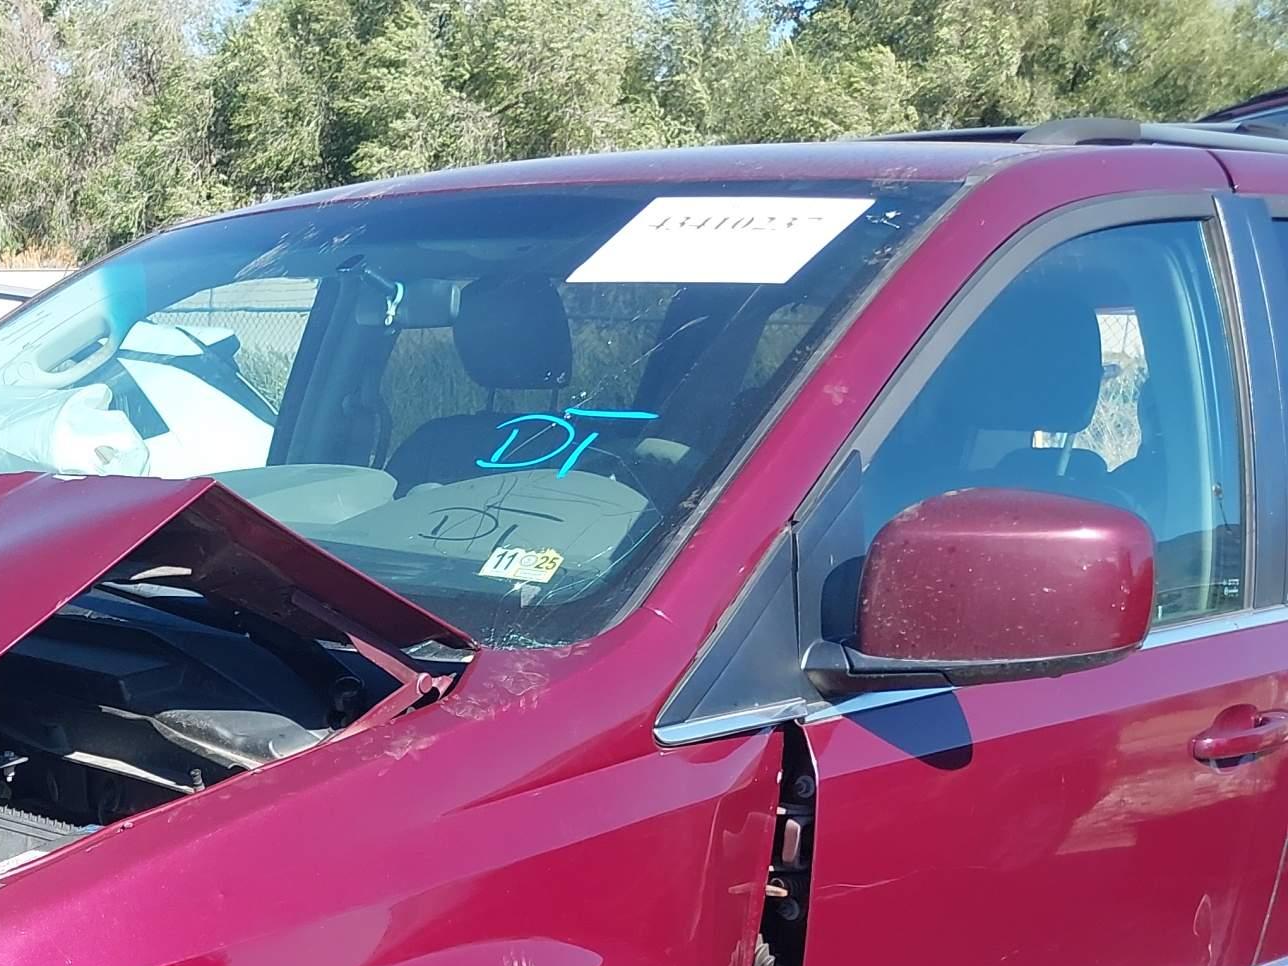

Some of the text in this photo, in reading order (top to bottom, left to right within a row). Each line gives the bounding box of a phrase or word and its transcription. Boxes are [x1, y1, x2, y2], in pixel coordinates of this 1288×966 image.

[475, 407, 660, 480] DT
[492, 551, 560, 571] 11 25
